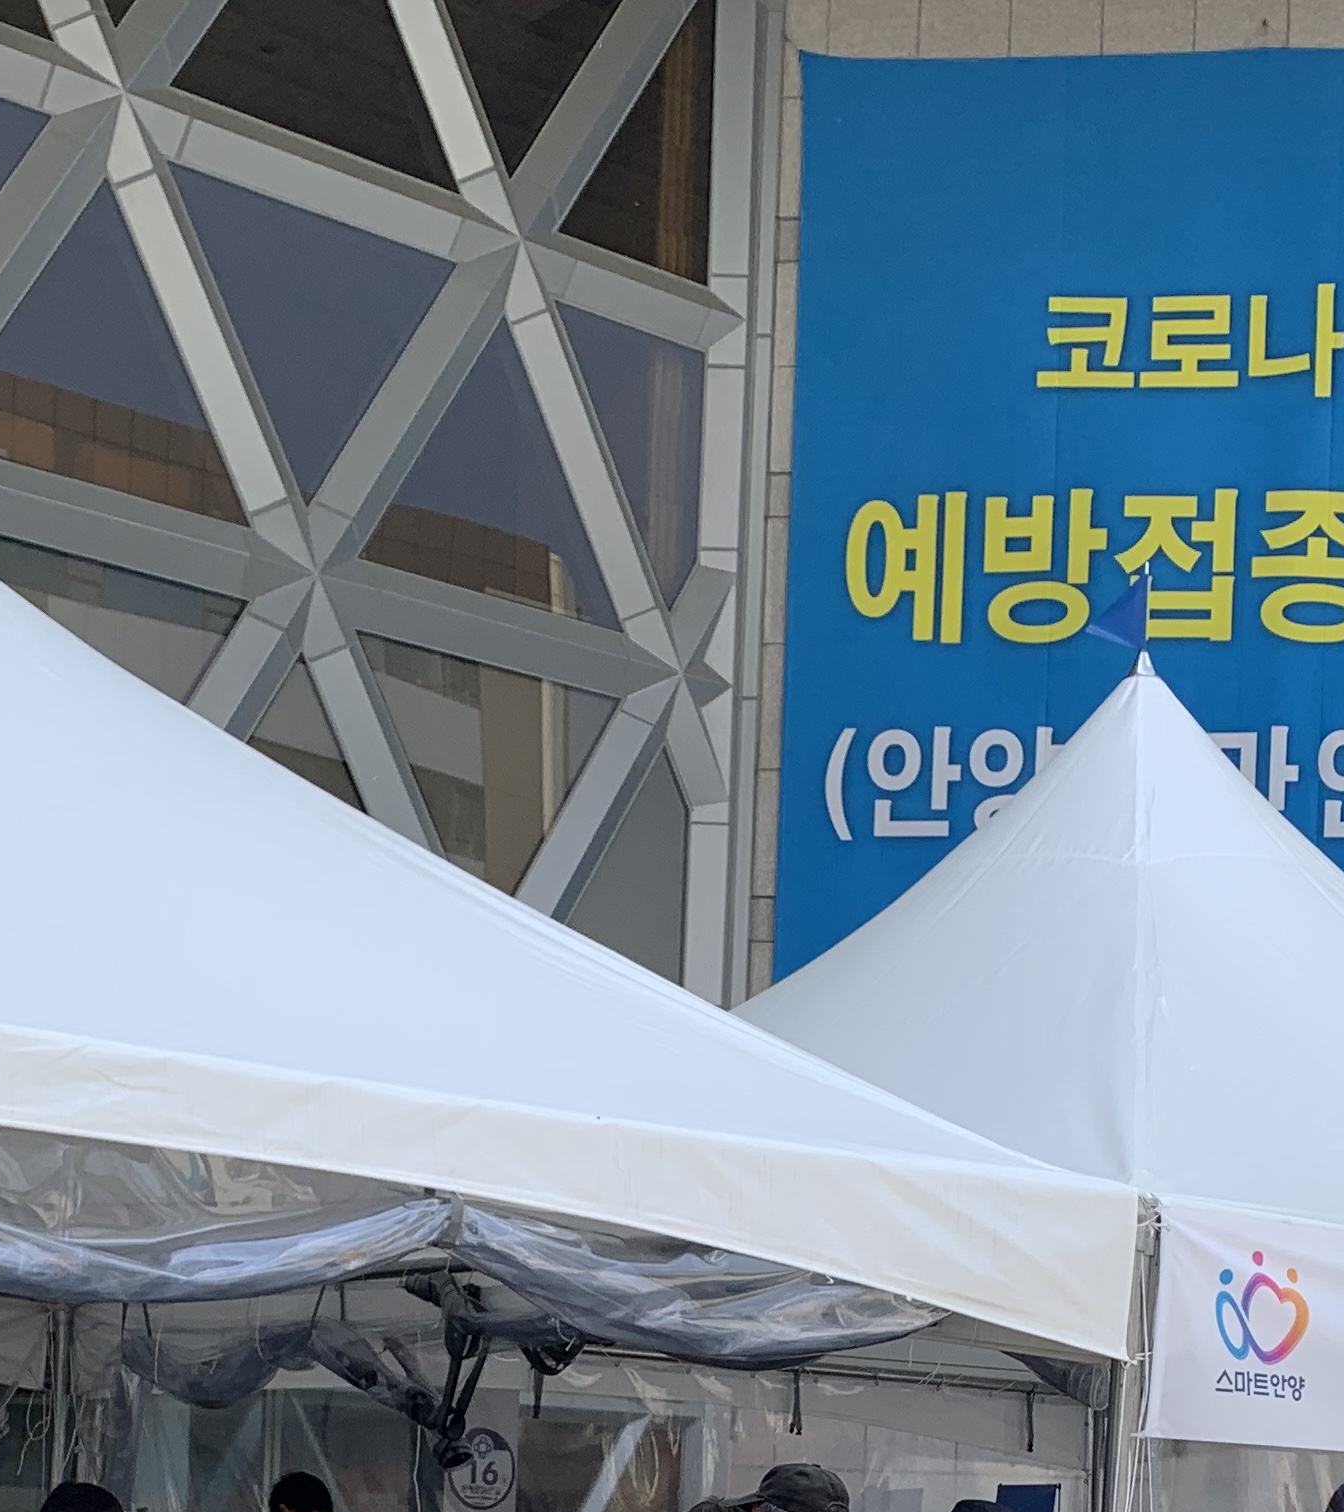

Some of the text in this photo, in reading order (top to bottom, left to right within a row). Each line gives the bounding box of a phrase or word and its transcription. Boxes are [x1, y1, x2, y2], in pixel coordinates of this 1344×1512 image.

[824, 725, 1066, 842] (안양
[1215, 1369, 1306, 1402] 스마트안양
[467, 1460, 498, 1486] 16
